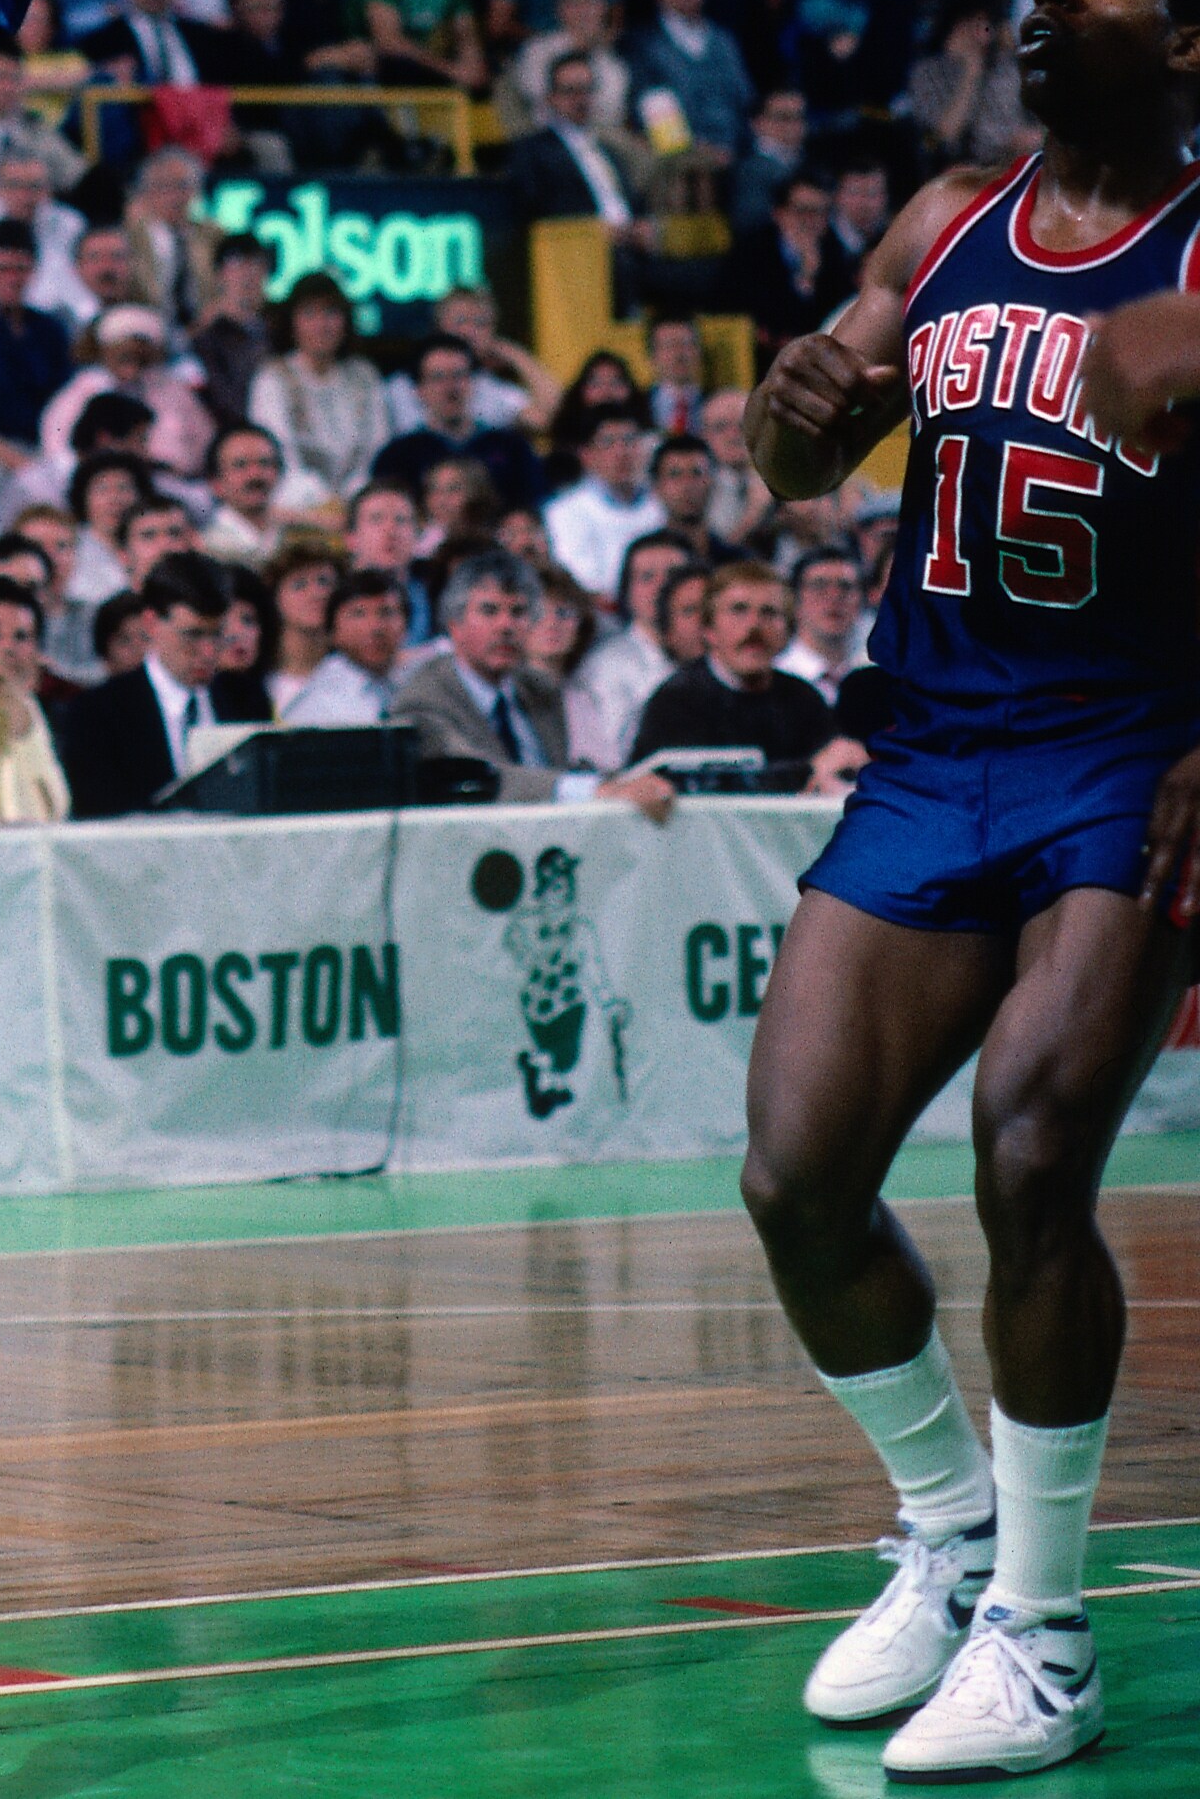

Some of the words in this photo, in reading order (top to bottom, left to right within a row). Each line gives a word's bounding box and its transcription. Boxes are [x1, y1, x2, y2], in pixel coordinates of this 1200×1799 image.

[908, 302, 1161, 479] PISTO
[922, 434, 1104, 610] 15
[106, 944, 399, 1059] BOSTON
[686, 922, 785, 1023] CE
